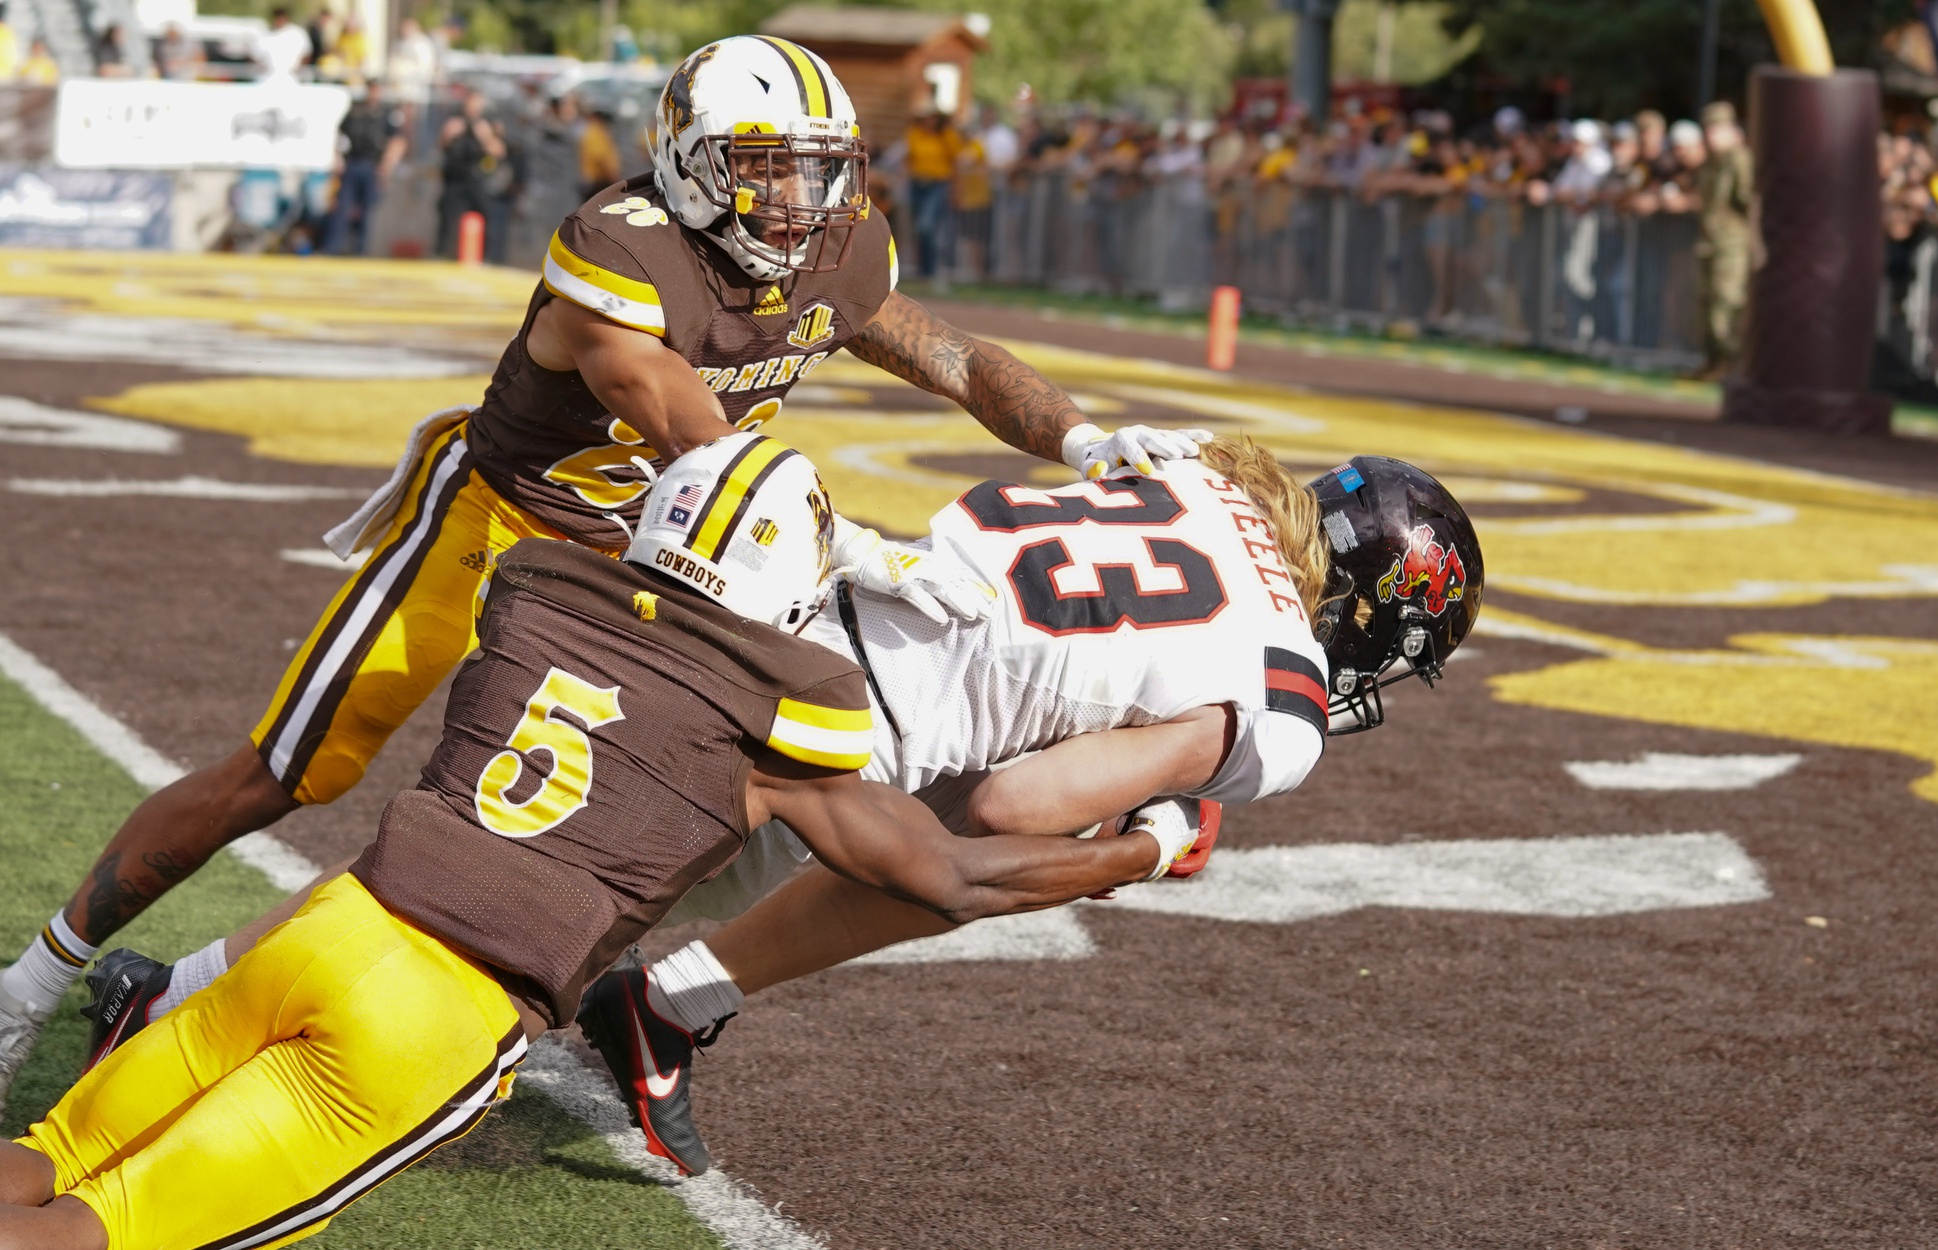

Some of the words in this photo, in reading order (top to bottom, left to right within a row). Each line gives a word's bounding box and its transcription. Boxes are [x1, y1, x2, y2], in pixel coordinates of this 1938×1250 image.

[754, 304, 788, 316] adidas
[692, 351, 829, 393] YOMING
[655, 548, 726, 596] COWBOYS
[957, 476, 1229, 637] 33
[475, 666, 626, 838] 5
[103, 974, 132, 1024] VAPOR
